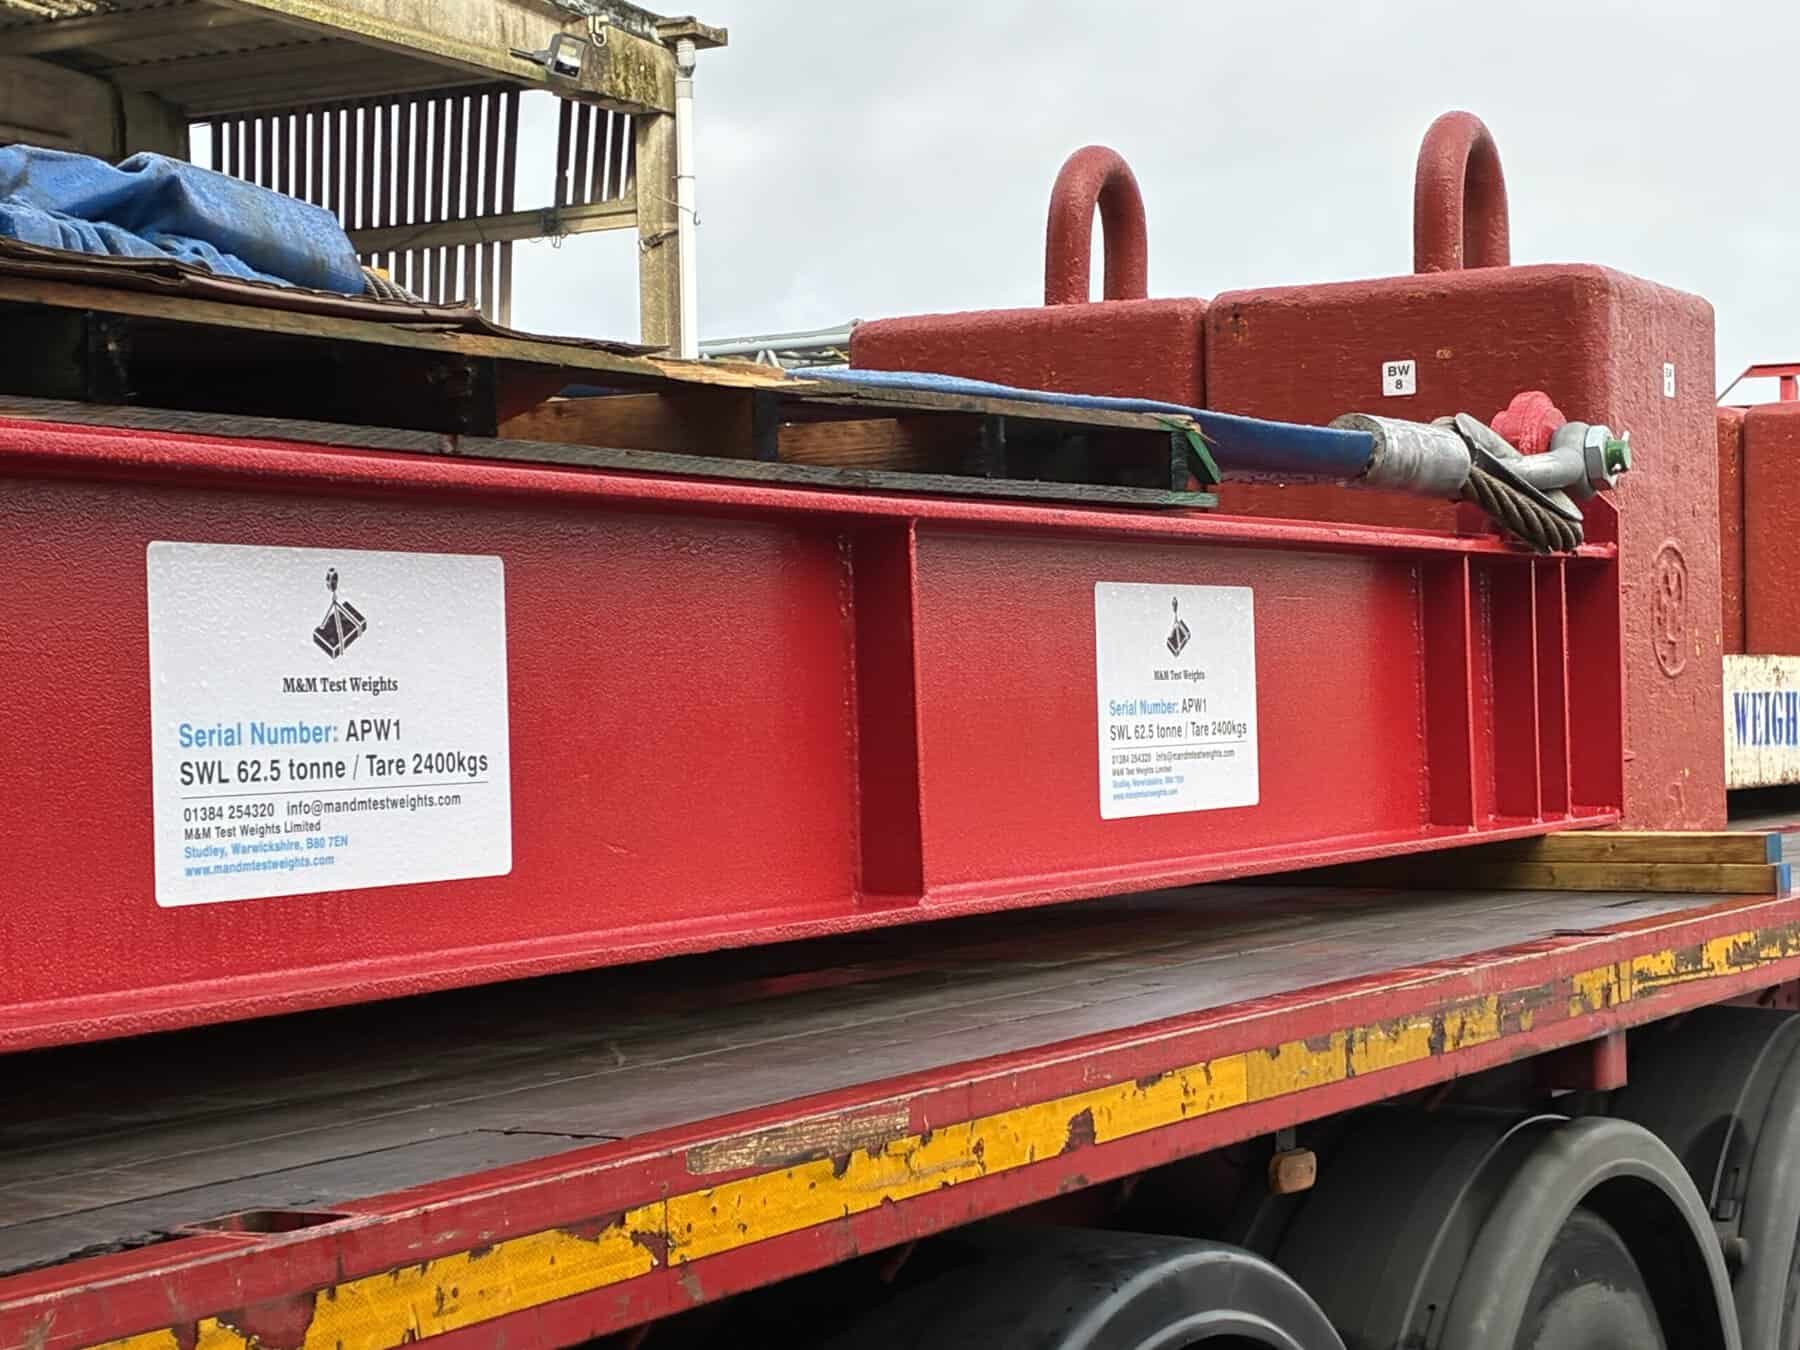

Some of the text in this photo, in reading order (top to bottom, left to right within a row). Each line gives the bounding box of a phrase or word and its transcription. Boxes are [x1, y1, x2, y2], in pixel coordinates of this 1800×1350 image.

[1388, 364, 1410, 377] BW
[1395, 378, 1403, 390] 8
[282, 676, 399, 696] M&M Test Weights
[1109, 697, 1207, 717] Serial Number: APW1
[179, 718, 401, 748] Serial Number: APW1
[1110, 725, 1132, 741] SWL
[1134, 723, 1154, 739] 62.5
[1156, 721, 1183, 738] tonne
[1191, 721, 1209, 736] Tare
[1211, 720, 1248, 738] 2400kgs
[180, 751, 488, 785] SWL 62.5 tonne / Tare 2400kgs
[184, 793, 461, 823] 01384 254320 info@mandmtestweights.com
[184, 820, 321, 841] M&M Test Weights Limited
[184, 844, 228, 861] Studley,
[231, 839, 303, 856] Warwickshire,
[328, 835, 349, 848] 7EN
[185, 853, 335, 877] www.mandmtestweights.com
